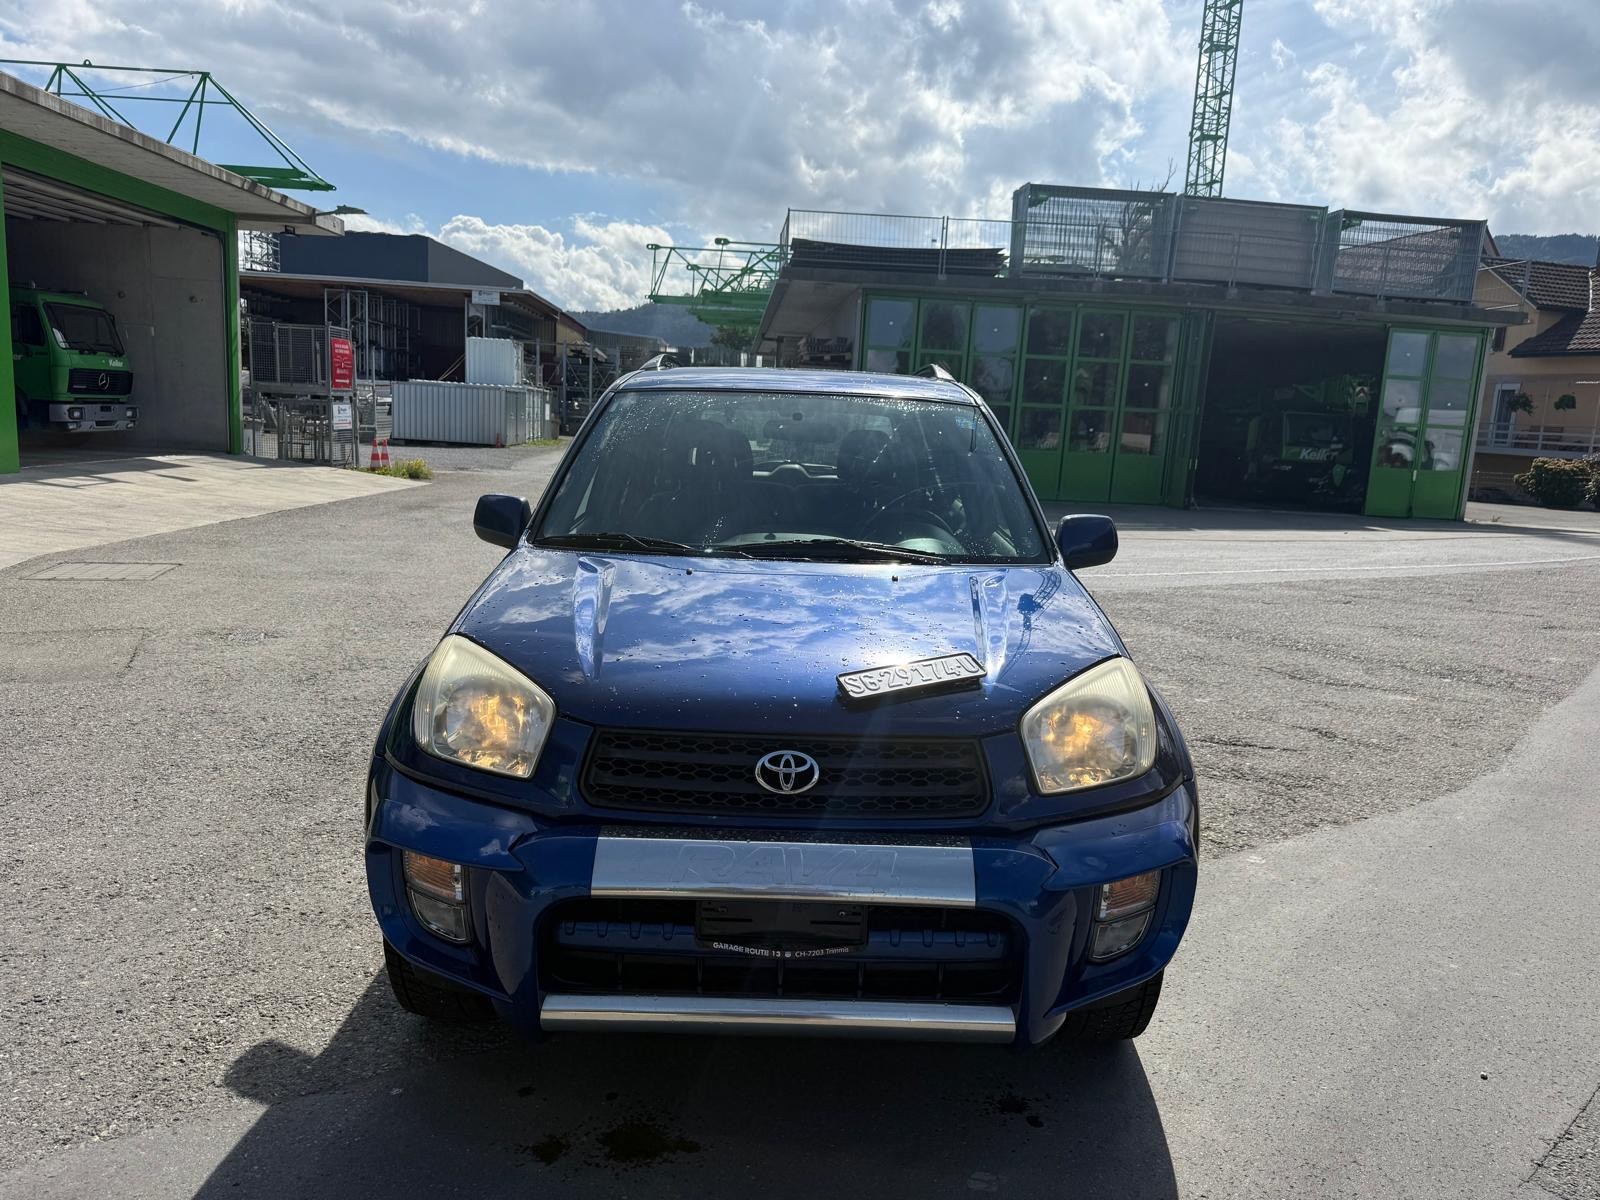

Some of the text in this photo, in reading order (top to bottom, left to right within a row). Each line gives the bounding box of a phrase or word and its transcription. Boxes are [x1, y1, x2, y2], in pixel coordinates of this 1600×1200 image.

[670, 845, 903, 894] RAV4
[712, 941, 744, 953] GARAGE
[745, 947, 769, 957] ROUTE
[771, 950, 781, 958] 13
